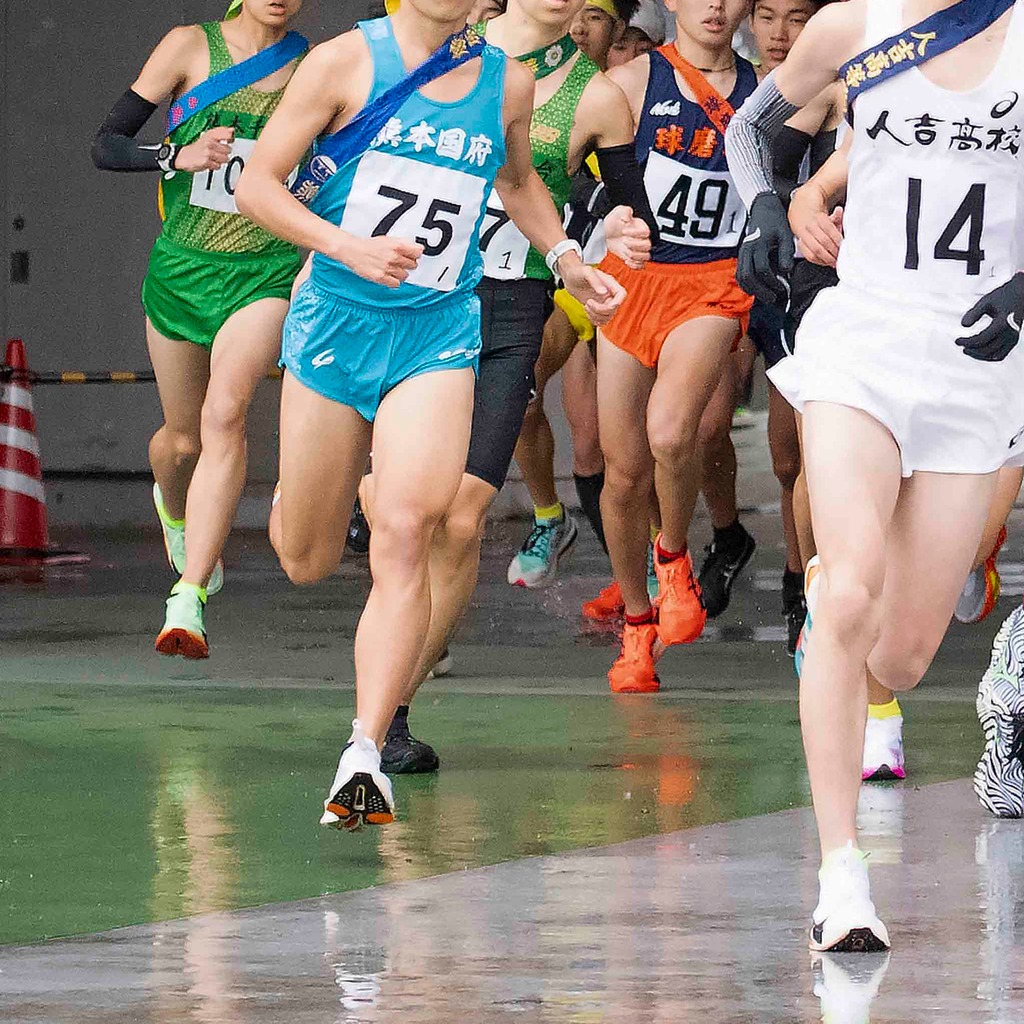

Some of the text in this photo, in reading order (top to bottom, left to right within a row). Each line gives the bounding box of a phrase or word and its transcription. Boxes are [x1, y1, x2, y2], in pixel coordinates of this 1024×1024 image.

[843, 31, 936, 112] 人吉高等
[371, 117, 493, 167] 熊本国府
[866, 110, 1022, 158] 人吉高校
[370, 184, 462, 257] 75
[657, 174, 730, 240] 49
[904, 177, 987, 276] 14
[498, 251, 513, 270] 1
